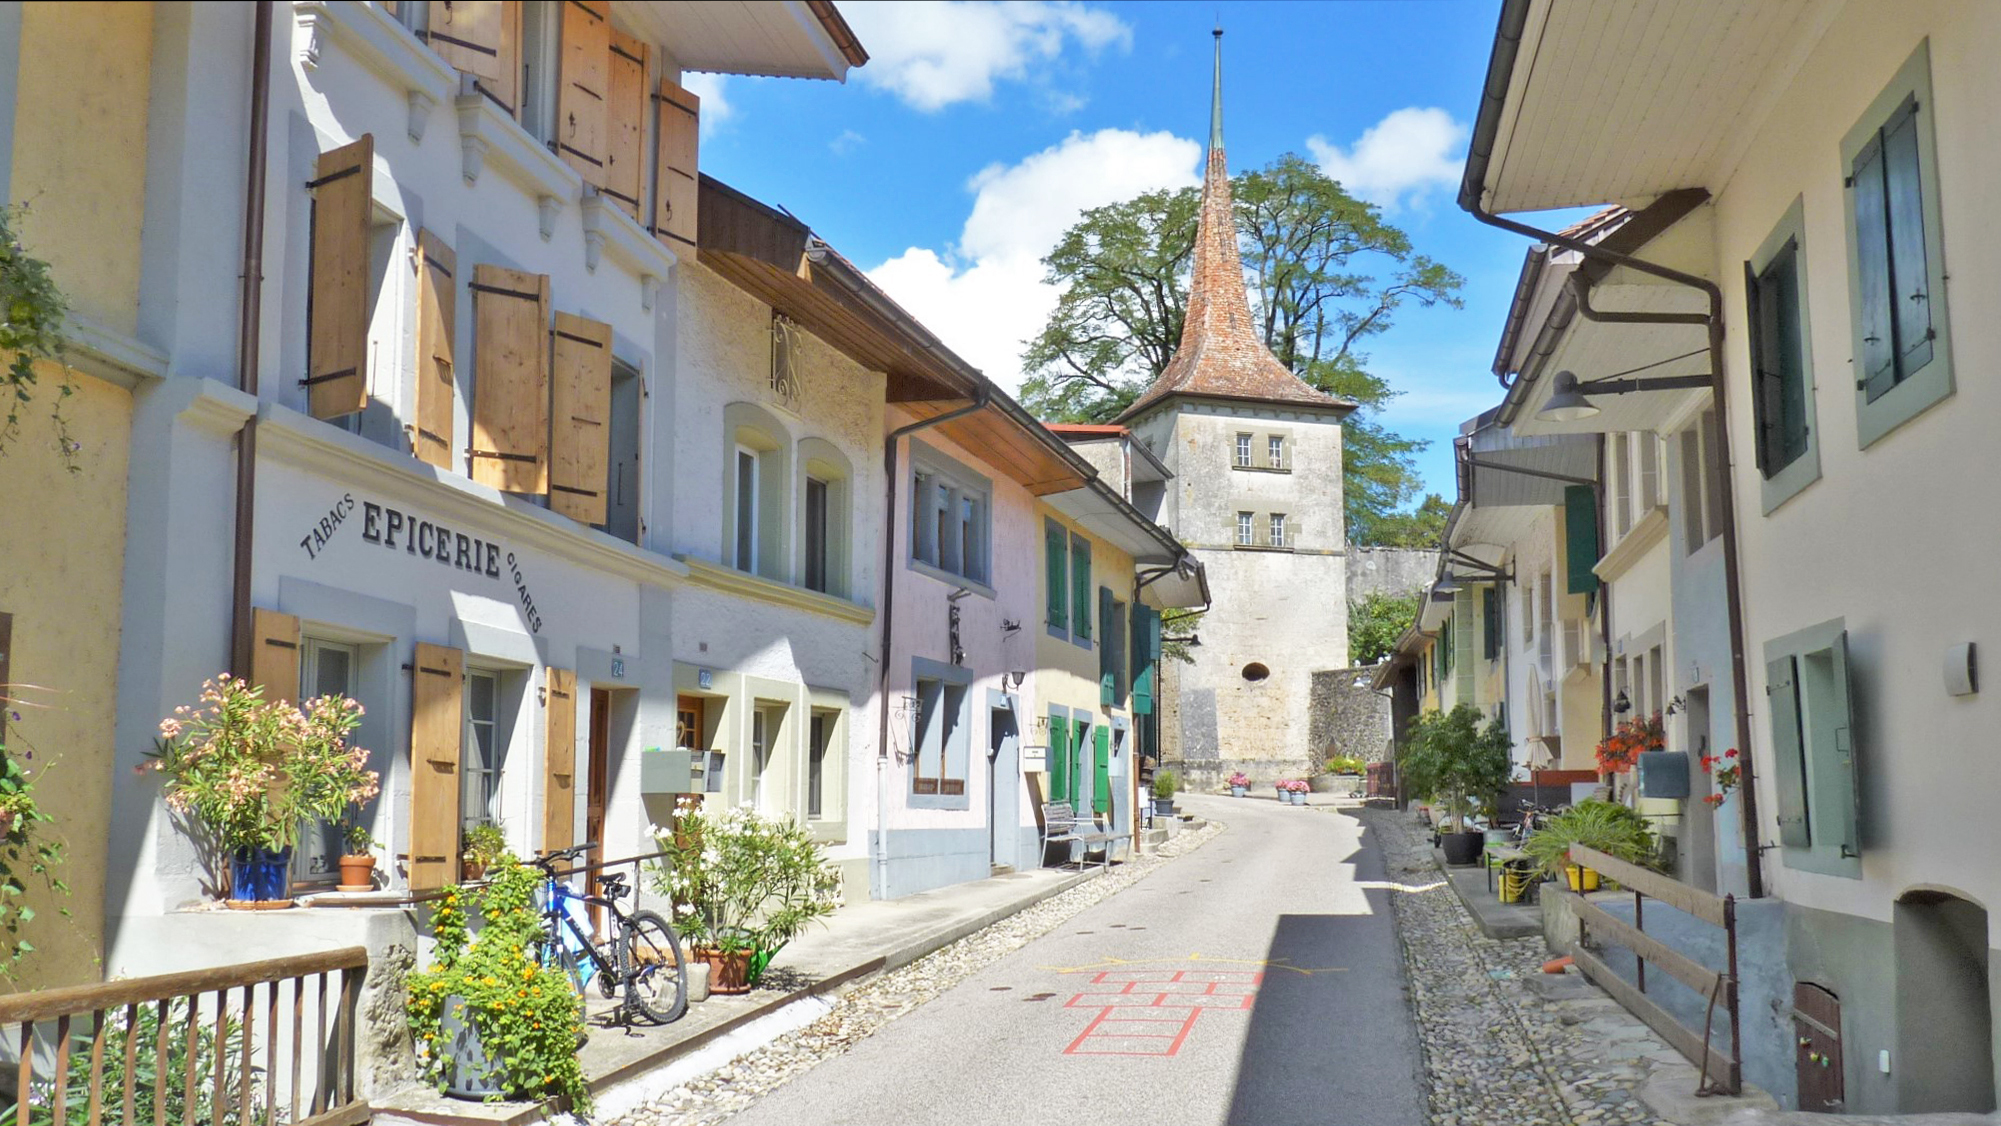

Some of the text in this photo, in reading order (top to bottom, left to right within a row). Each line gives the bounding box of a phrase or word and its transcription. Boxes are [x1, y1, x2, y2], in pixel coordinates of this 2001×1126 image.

[300, 493, 354, 560] TABACS
[362, 501, 500, 579] EPICERIE
[507, 552, 542, 633] CIGARES
[613, 661, 623, 677] 24
[700, 672, 711, 686] 22
